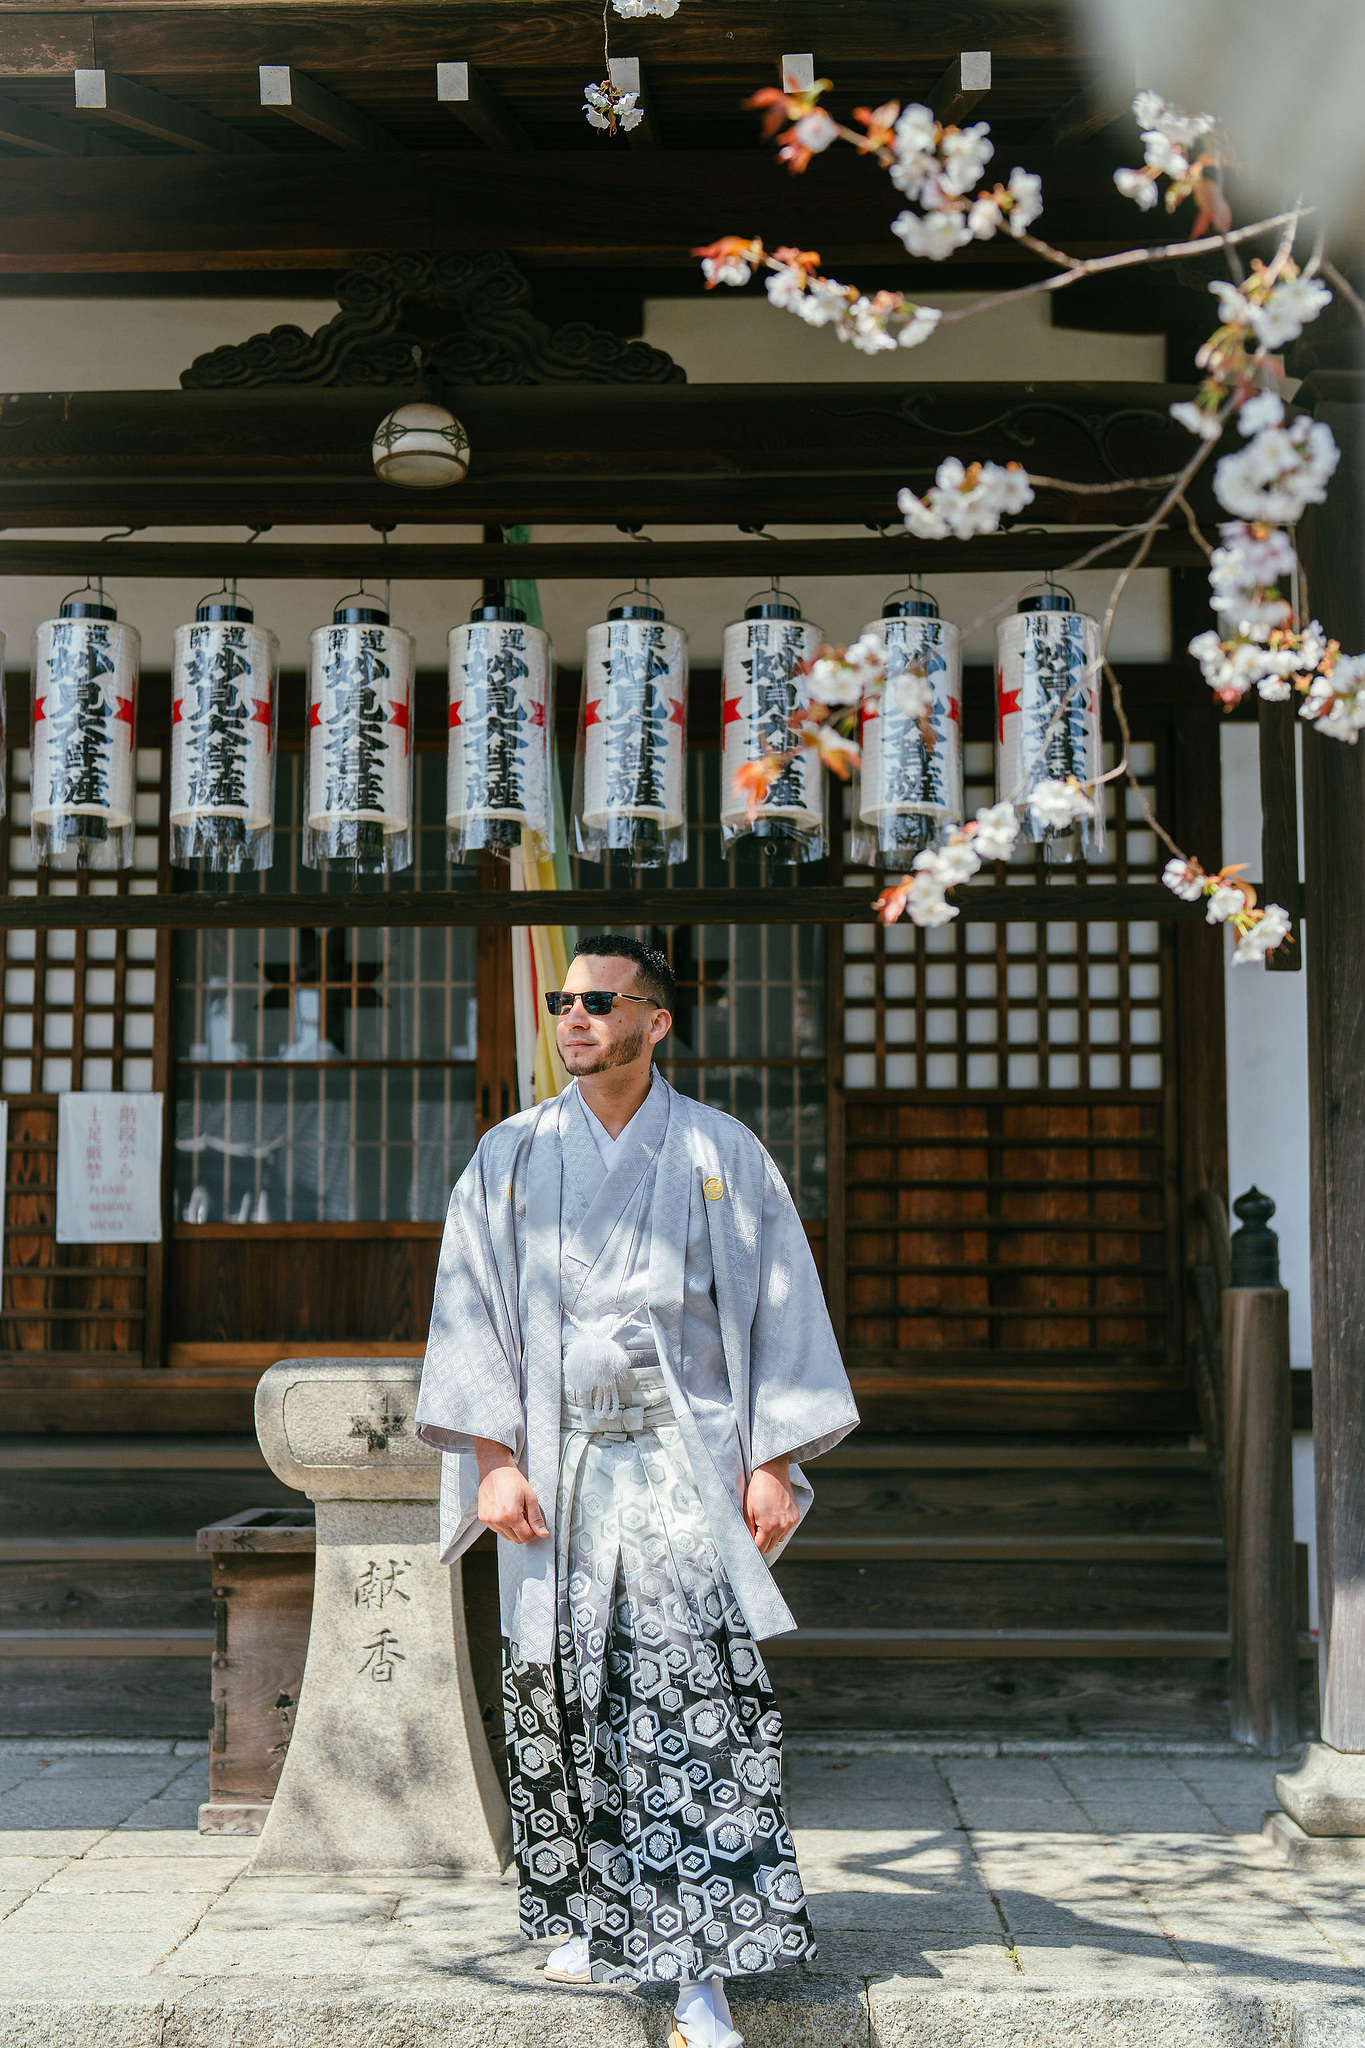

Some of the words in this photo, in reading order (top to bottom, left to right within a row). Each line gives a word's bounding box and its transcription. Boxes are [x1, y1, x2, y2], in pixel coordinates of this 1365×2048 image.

[52, 623, 111, 649] 開運
[190, 626, 248, 650] 開運
[328, 629, 387, 653] 開運
[468, 628, 527, 653] 開運
[607, 625, 666, 650] 開運
[747, 624, 806, 650] 開運
[885, 620, 943, 646] 開運
[47, 646, 115, 808] 妙見大菩薩
[184, 648, 252, 809] 妙見大菩薩
[322, 651, 390, 813] 妙見大菩薩
[462, 650, 530, 812] 妙見大菩薩
[601, 647, 670, 810] 妙見大菩薩
[86, 1105, 103, 1180] 土足厳禁
[119, 1105, 137, 1180] 階段から
[88, 1184, 127, 1195] PLEASE
[88, 1202, 133, 1213] REMOVE
[90, 1220, 123, 1231] SHOES
[354, 1559, 413, 1683] 献香
